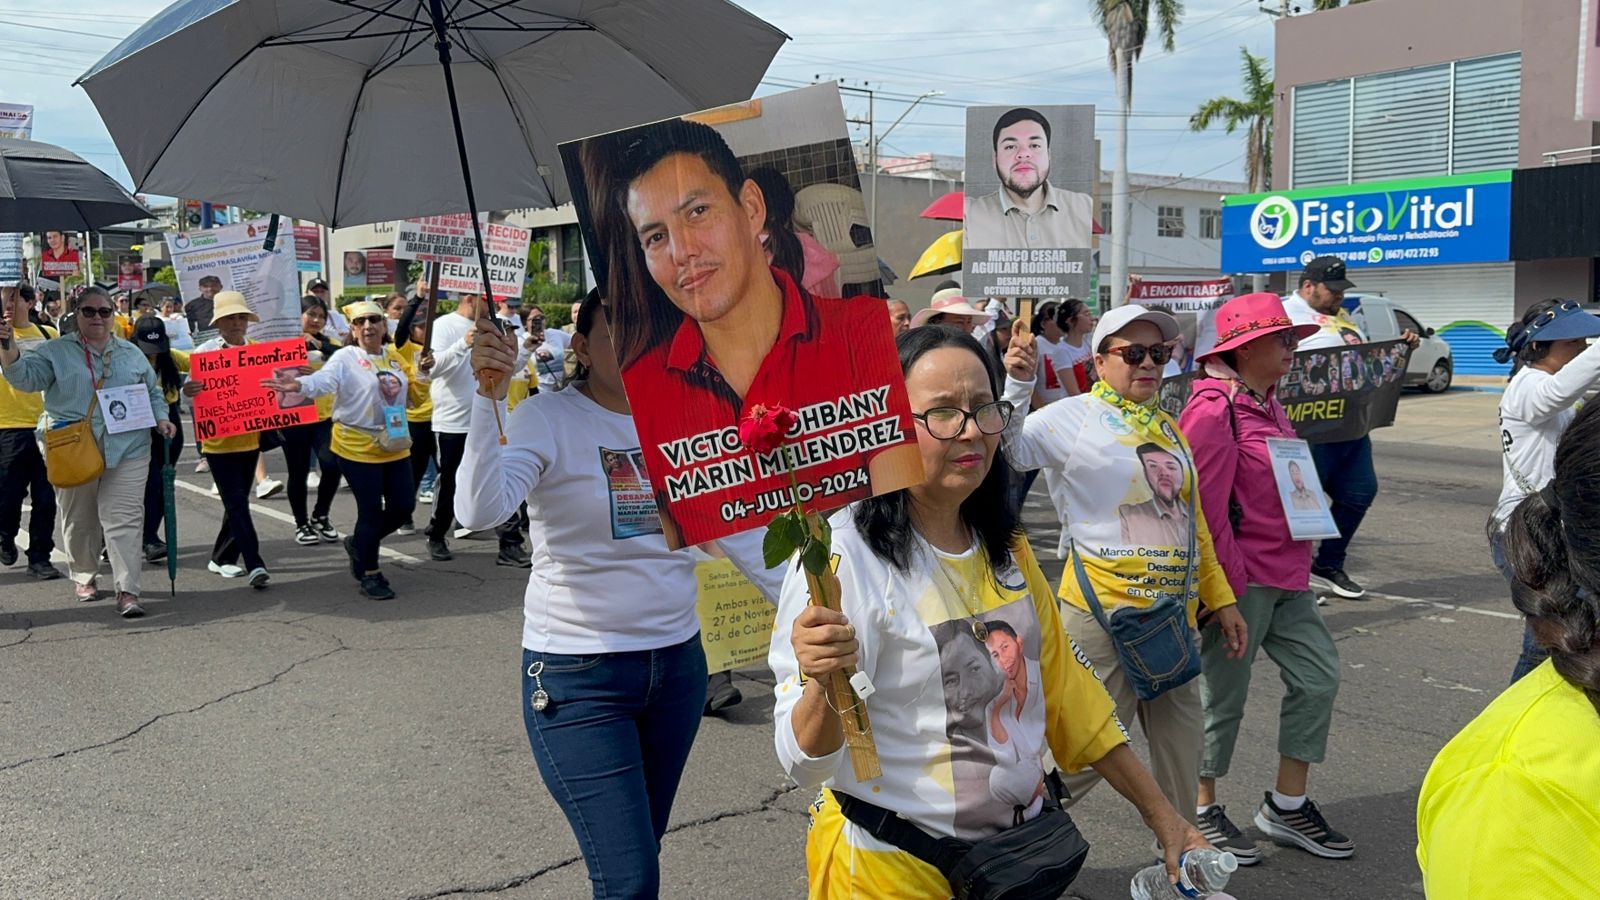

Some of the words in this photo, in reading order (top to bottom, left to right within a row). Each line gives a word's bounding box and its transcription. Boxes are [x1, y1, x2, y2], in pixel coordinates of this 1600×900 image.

[1301, 188, 1474, 237] FisioVital
[418, 233, 449, 246] ALBERTO
[451, 237, 460, 246] DE
[406, 242, 431, 254] IBARRA
[433, 244, 474, 258] BERRELLEZA
[988, 250, 1028, 262] MARCO
[1030, 250, 1067, 262] CESAR
[187, 262, 216, 272] ARSENIO
[484, 253, 525, 270] TOMAS
[972, 262, 1019, 274] AGUILAR
[1021, 262, 1084, 274] RODRIGUEZ
[442, 264, 479, 279] FELIX
[997, 277, 1056, 286] DESAPARECIDO
[984, 286, 1020, 295] OCTUBRE
[1022, 286, 1032, 295] 24
[1033, 286, 1047, 295] DEL
[1048, 286, 1070, 295] 2024
[1140, 285, 1148, 298] A
[200, 354, 231, 372] Hasta
[226, 397, 266, 413] ALBERTO
[198, 420, 216, 440] NO
[243, 412, 301, 432] LLEVARON
[658, 426, 744, 468] VICTO
[784, 384, 890, 438] OHBANY
[664, 454, 756, 503] MARIN
[756, 415, 906, 479] MELENDREZ
[720, 467, 869, 522] 04-JULIO-2024
[1100, 548, 1134, 557] Marco
[1137, 548, 1170, 558] Cesar
[1143, 576, 1156, 585] de
[1127, 587, 1141, 596] en
[715, 598, 748, 612] Ambos
[713, 616, 726, 627] 27
[729, 614, 742, 624] de
[728, 628, 740, 638] de
